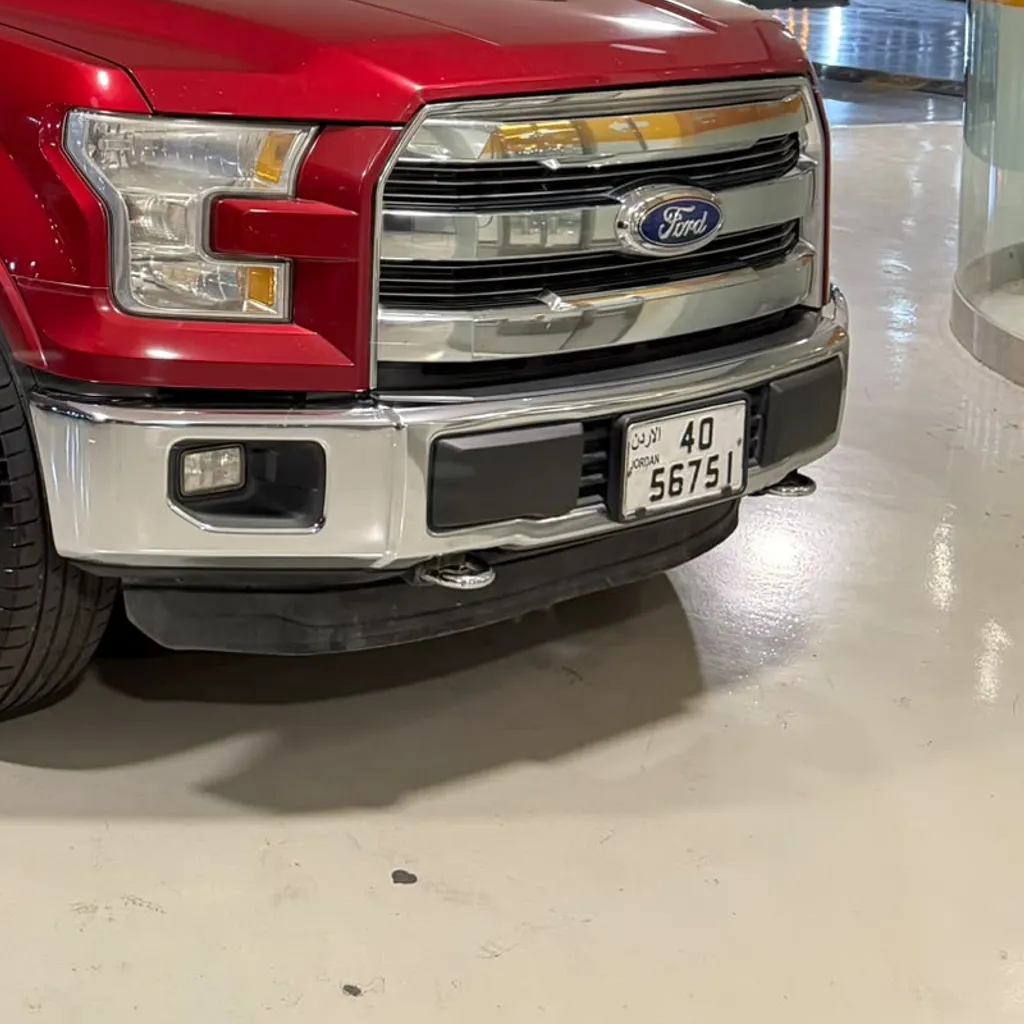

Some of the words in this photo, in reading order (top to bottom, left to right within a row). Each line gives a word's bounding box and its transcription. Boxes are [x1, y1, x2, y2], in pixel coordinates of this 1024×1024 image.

[658, 205, 708, 240] Ford
[680, 416, 714, 454] 40
[631, 453, 660, 470] JORDAN
[649, 451, 733, 502] 56751
